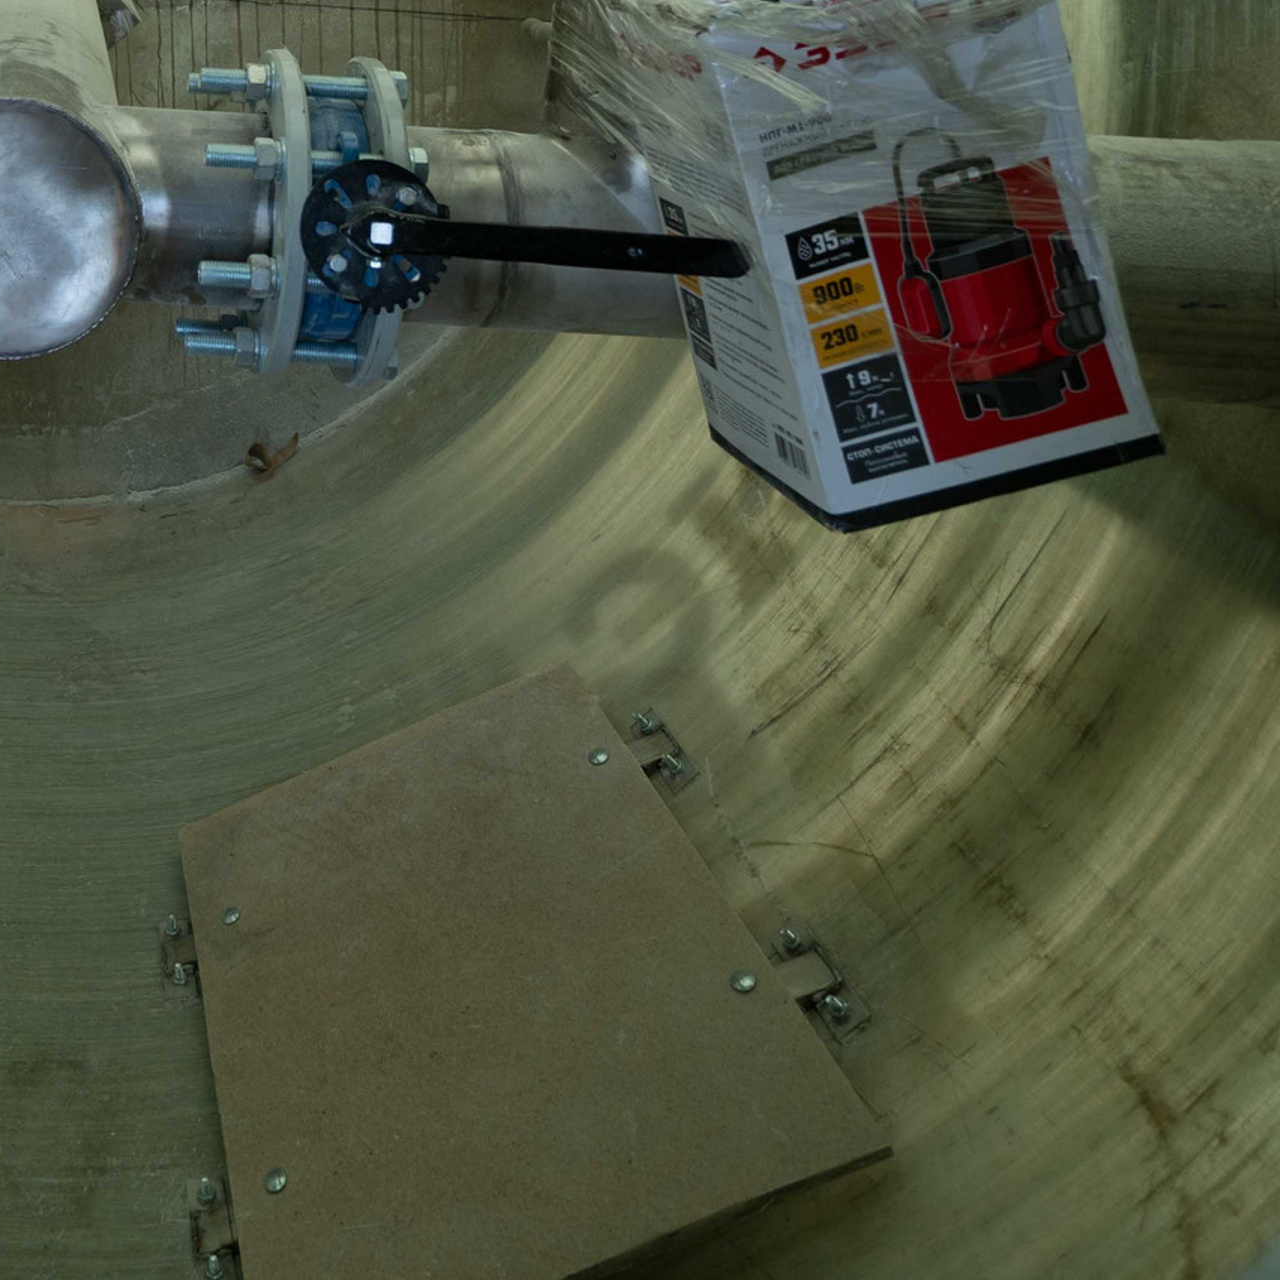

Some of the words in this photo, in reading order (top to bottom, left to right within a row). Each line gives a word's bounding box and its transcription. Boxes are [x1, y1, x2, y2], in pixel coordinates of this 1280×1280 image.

[811, 229, 839, 254] 35
[812, 276, 854, 305] 900
[820, 324, 859, 351] 230
[857, 369, 872, 386] 9
[866, 402, 879, 419] 7
[847, 435, 920, 461] СТОП-СИСТЕМА
